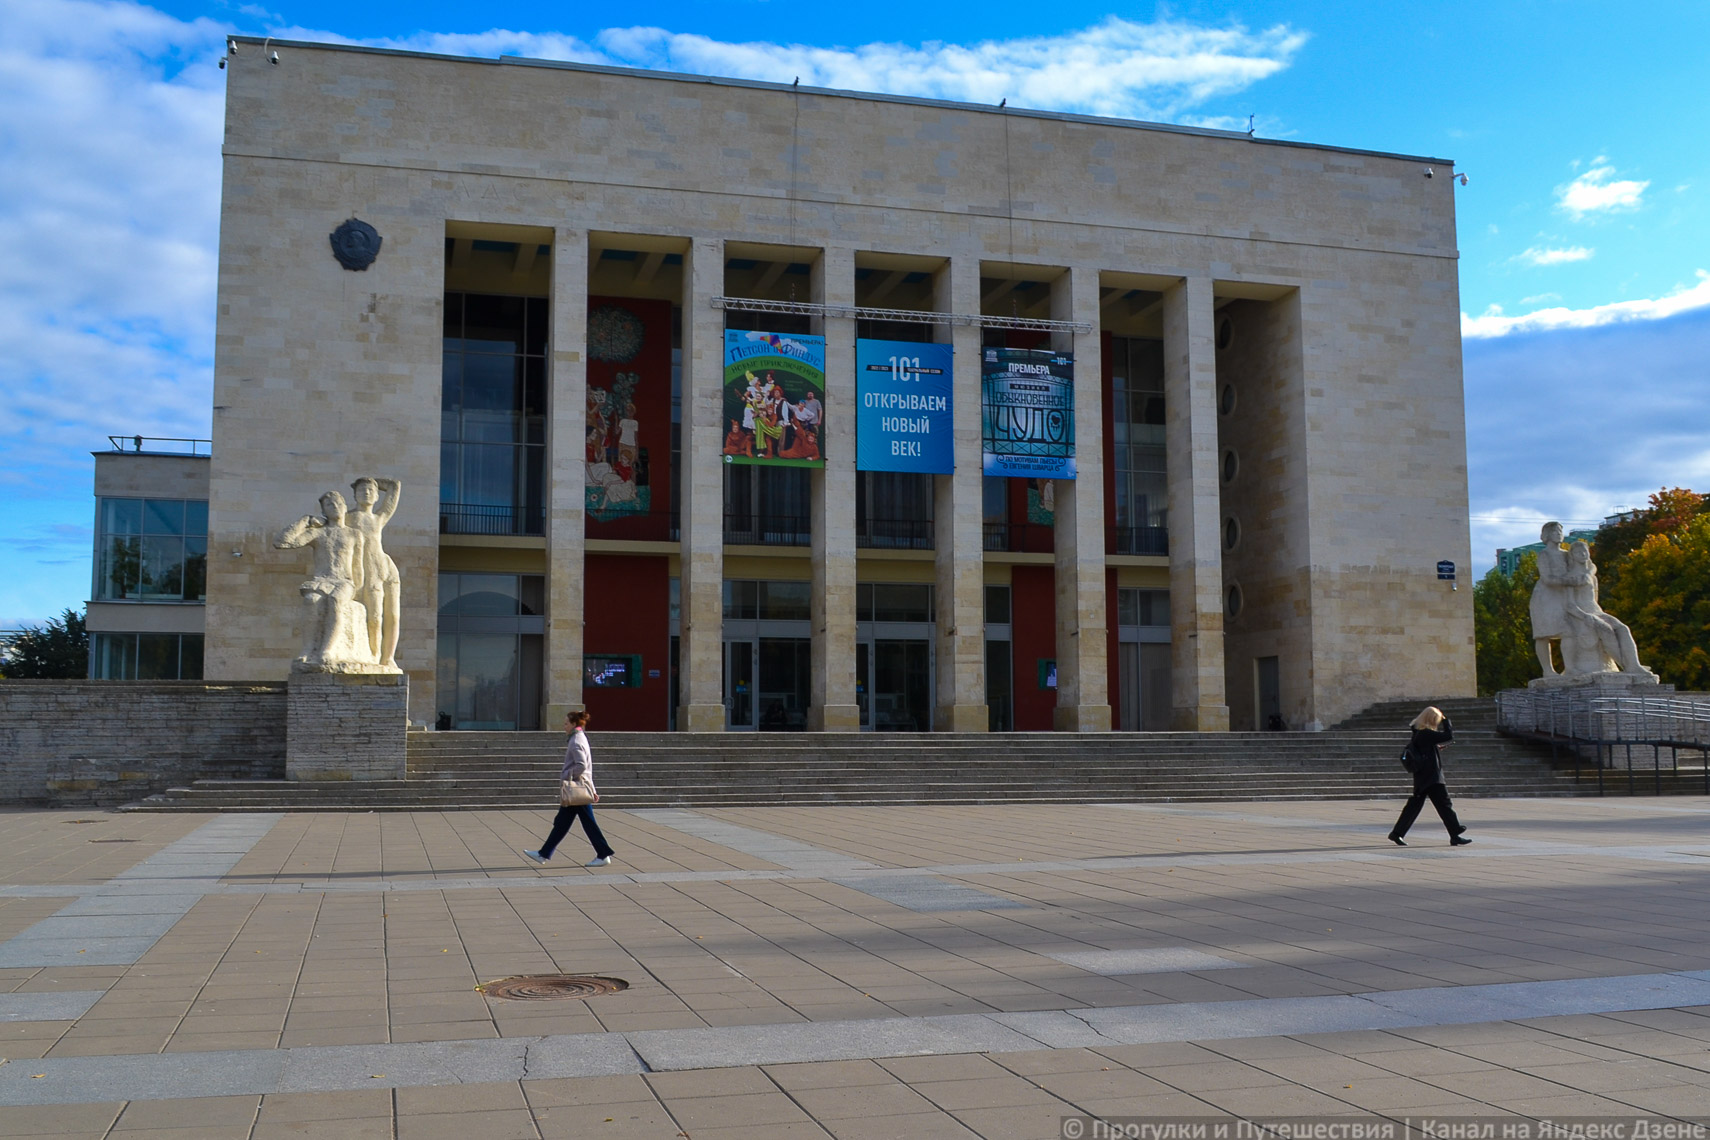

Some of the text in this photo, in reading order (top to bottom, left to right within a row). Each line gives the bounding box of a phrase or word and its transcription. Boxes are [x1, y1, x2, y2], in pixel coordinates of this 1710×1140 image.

[889, 356, 920, 382] 101
[1008, 362, 1050, 375] ПРЕМЬЕРА
[864, 392, 947, 412] ОТКРЫВАЕМ
[995, 391, 1065, 407] ОБЫКНОВЕННОЕ
[882, 415, 930, 434] НОВЫЙ
[995, 405, 1065, 443] ЧУДО
[891, 440, 921, 457] ВЕК!
